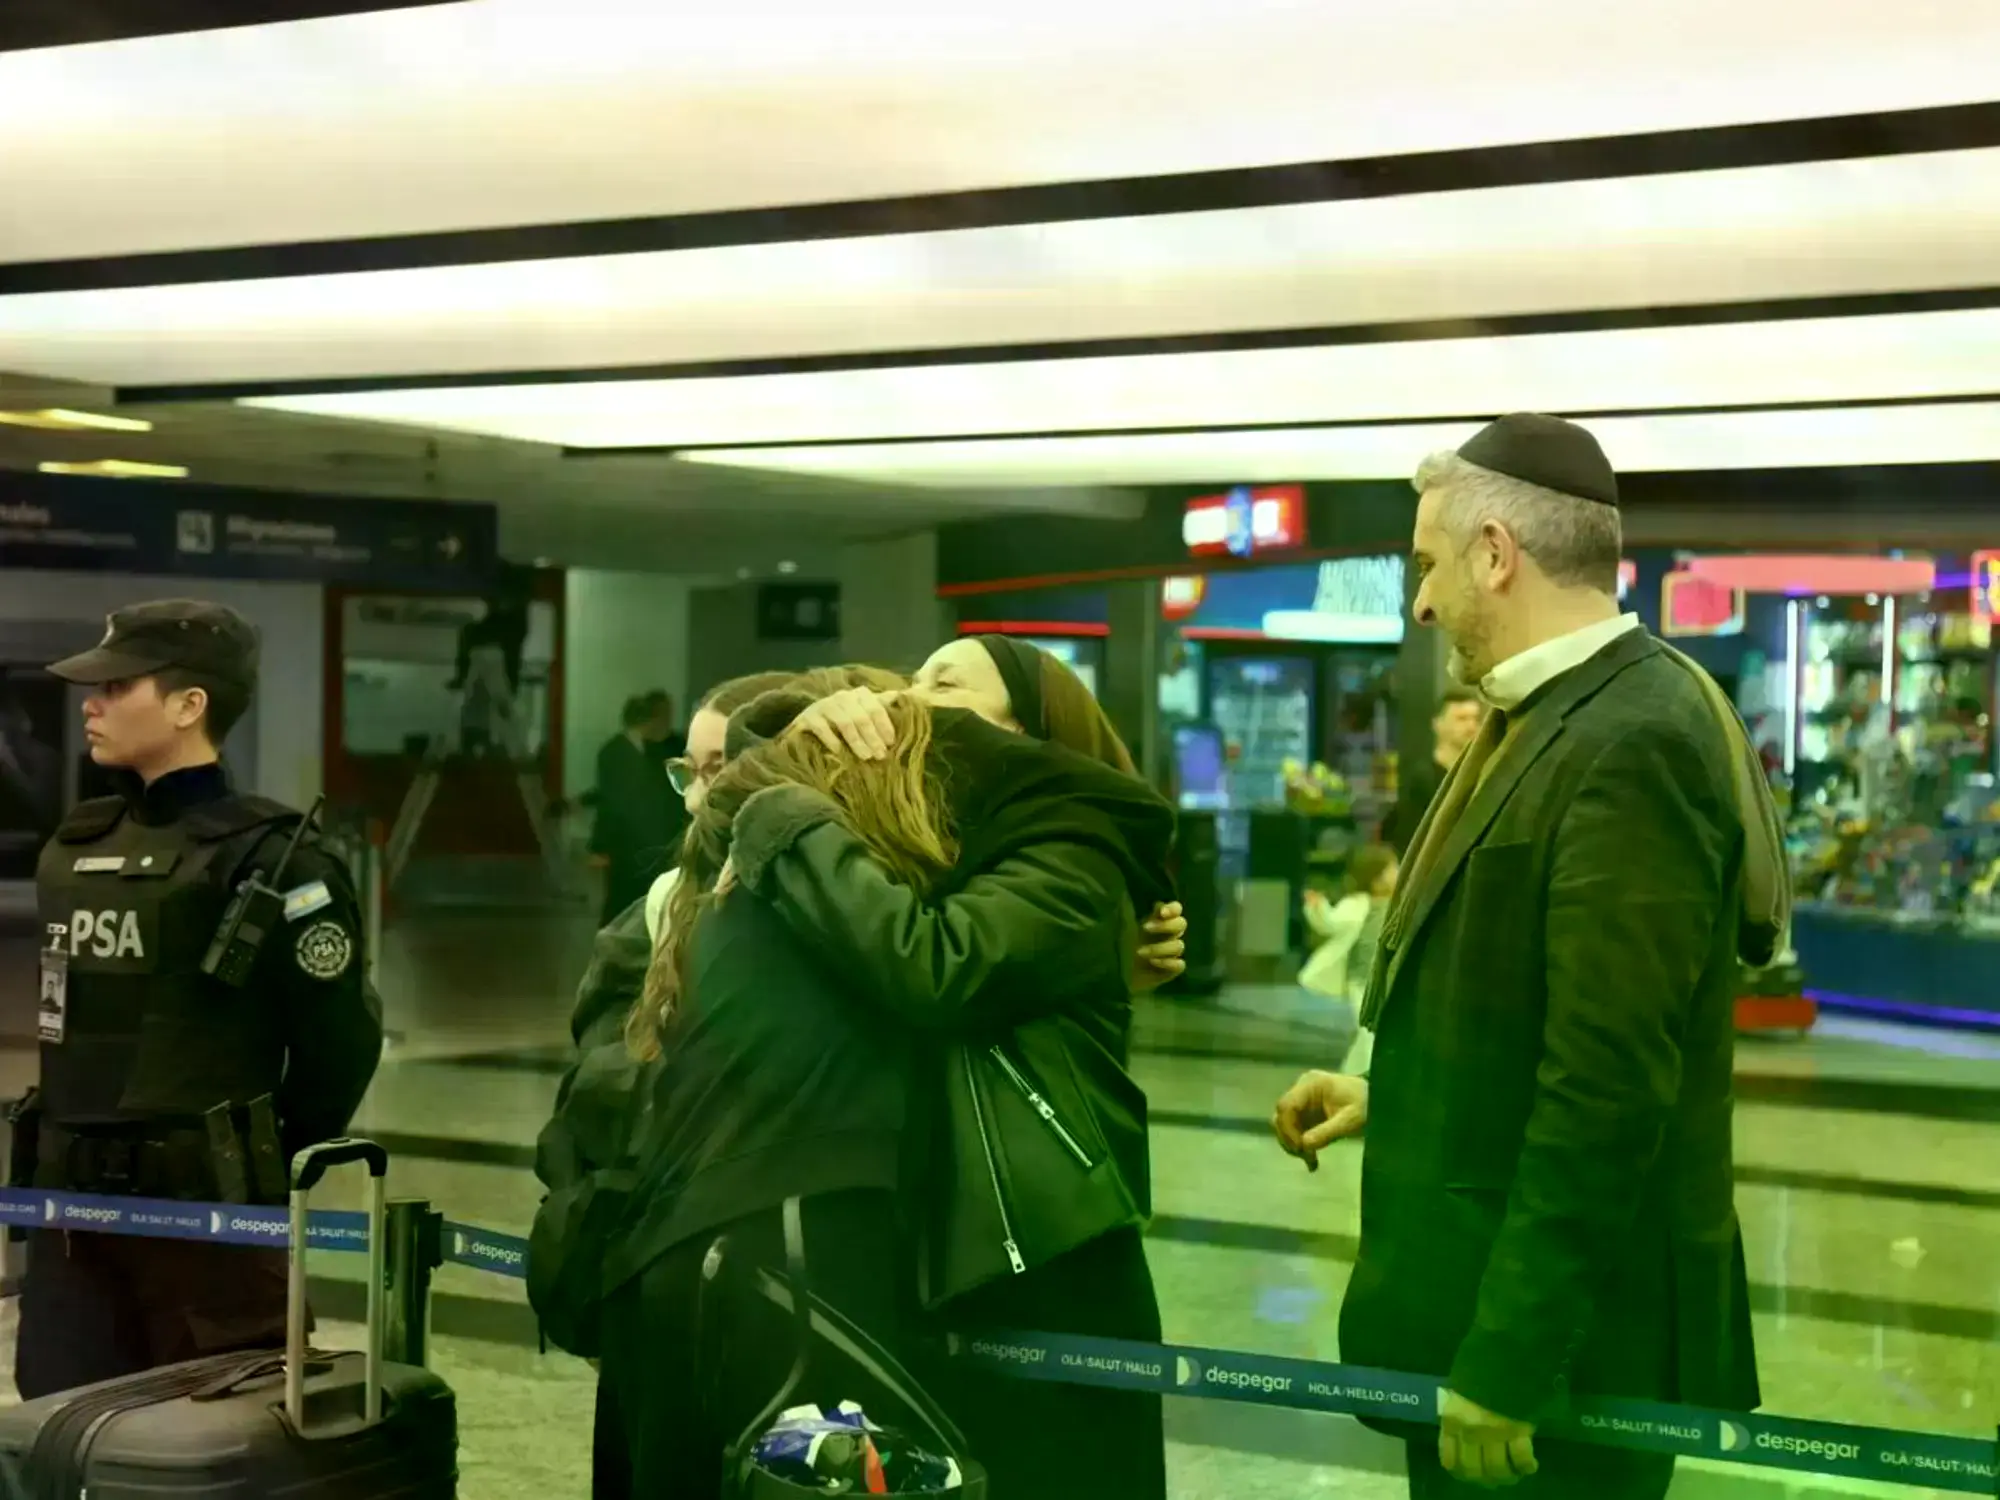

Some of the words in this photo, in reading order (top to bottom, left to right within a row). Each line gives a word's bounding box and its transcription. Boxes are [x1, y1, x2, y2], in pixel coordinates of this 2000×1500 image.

[70, 909, 145, 958] PSA
[64, 1203, 121, 1224] despegar
[472, 1241, 522, 1264] despegar
[972, 1339, 1047, 1364] despegar
[1206, 1366, 1292, 1392] despegar
[1755, 1431, 1861, 1461] despegar
